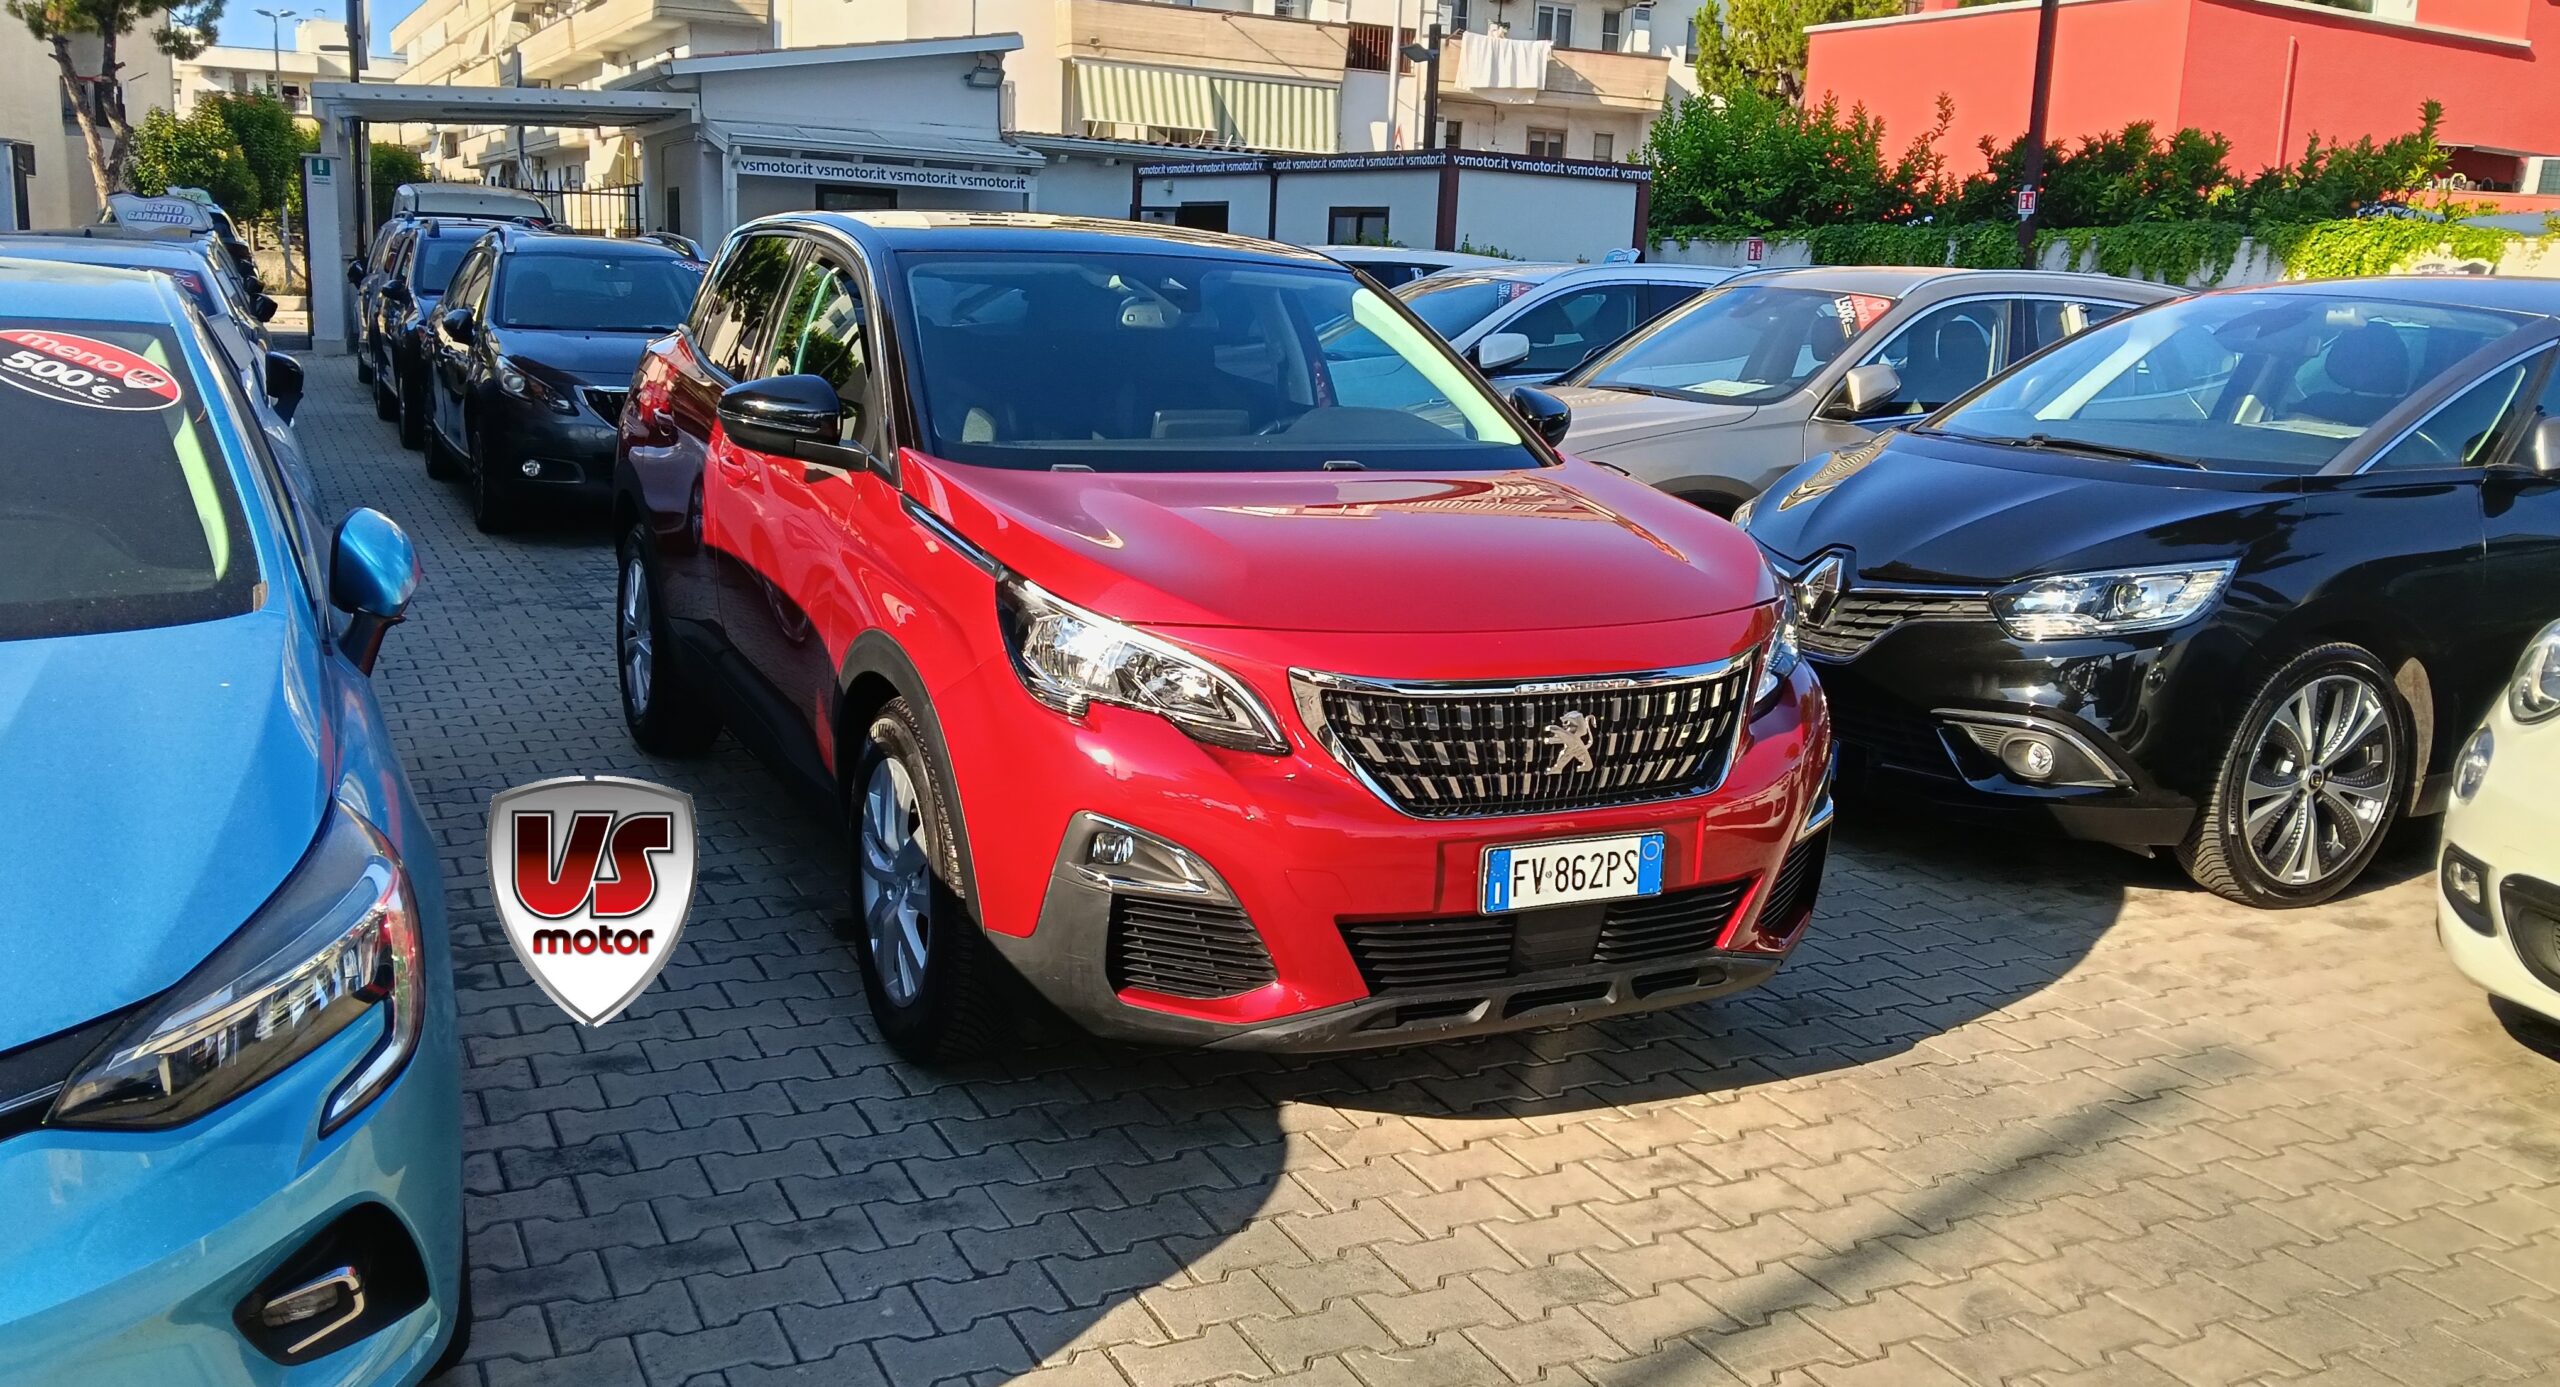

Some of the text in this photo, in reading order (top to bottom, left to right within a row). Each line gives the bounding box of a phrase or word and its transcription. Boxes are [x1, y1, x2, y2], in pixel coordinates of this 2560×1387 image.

[1293, 157, 1327, 169] vsmotor.it
[1329, 155, 1364, 168] vsmotor.it
[1366, 154, 1404, 166] vsmotor.it
[1406, 152, 1446, 166] vsmotor.it
[1454, 155, 1508, 169] vsmotor.it
[1511, 160, 1564, 174] vsmotor.it
[1567, 164, 1618, 178] vsmotor.it
[741, 161, 1026, 190] vsmotor.it vsmotor.it vsmotor.it vsmotor.it
[127, 211, 192, 225] GARANTITO
[145, 203, 183, 214] USATO
[16, 333, 125, 373] meno
